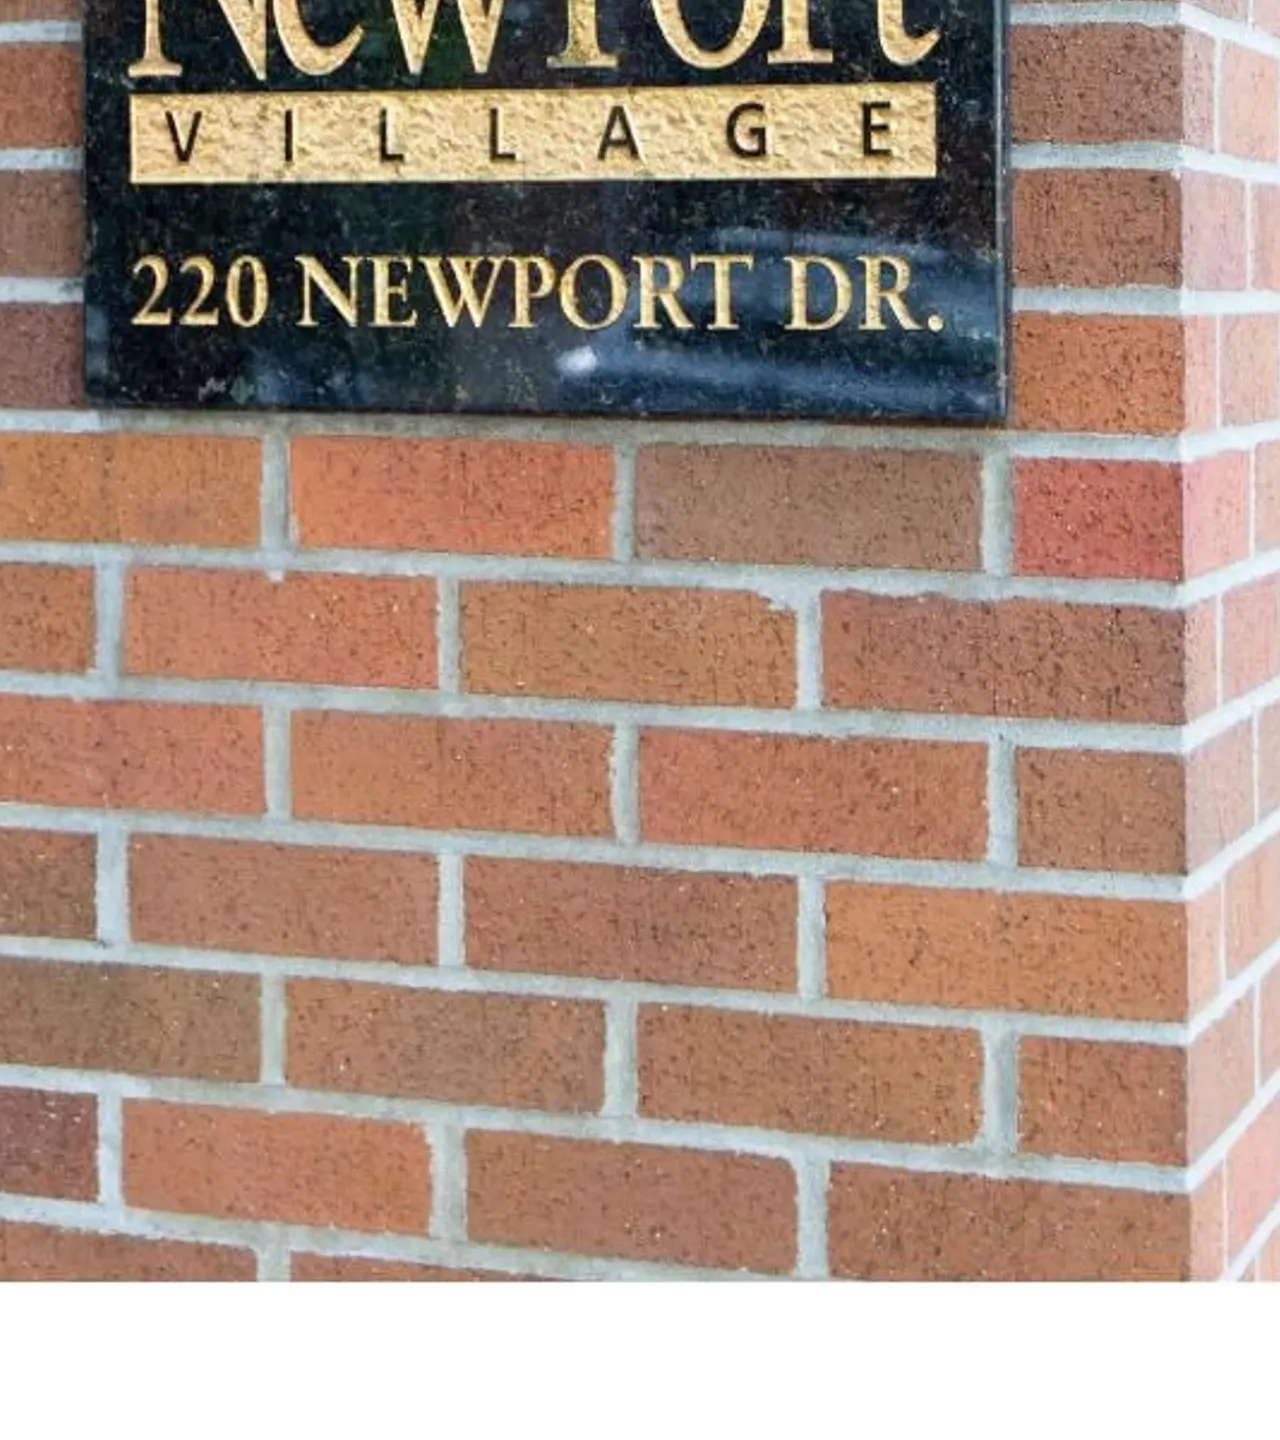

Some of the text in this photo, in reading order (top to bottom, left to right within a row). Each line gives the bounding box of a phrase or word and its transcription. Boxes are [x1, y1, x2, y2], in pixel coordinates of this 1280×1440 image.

[165, 100, 892, 162] VILLAGE
[131, 254, 945, 332] 220 NEWPORT DR.
